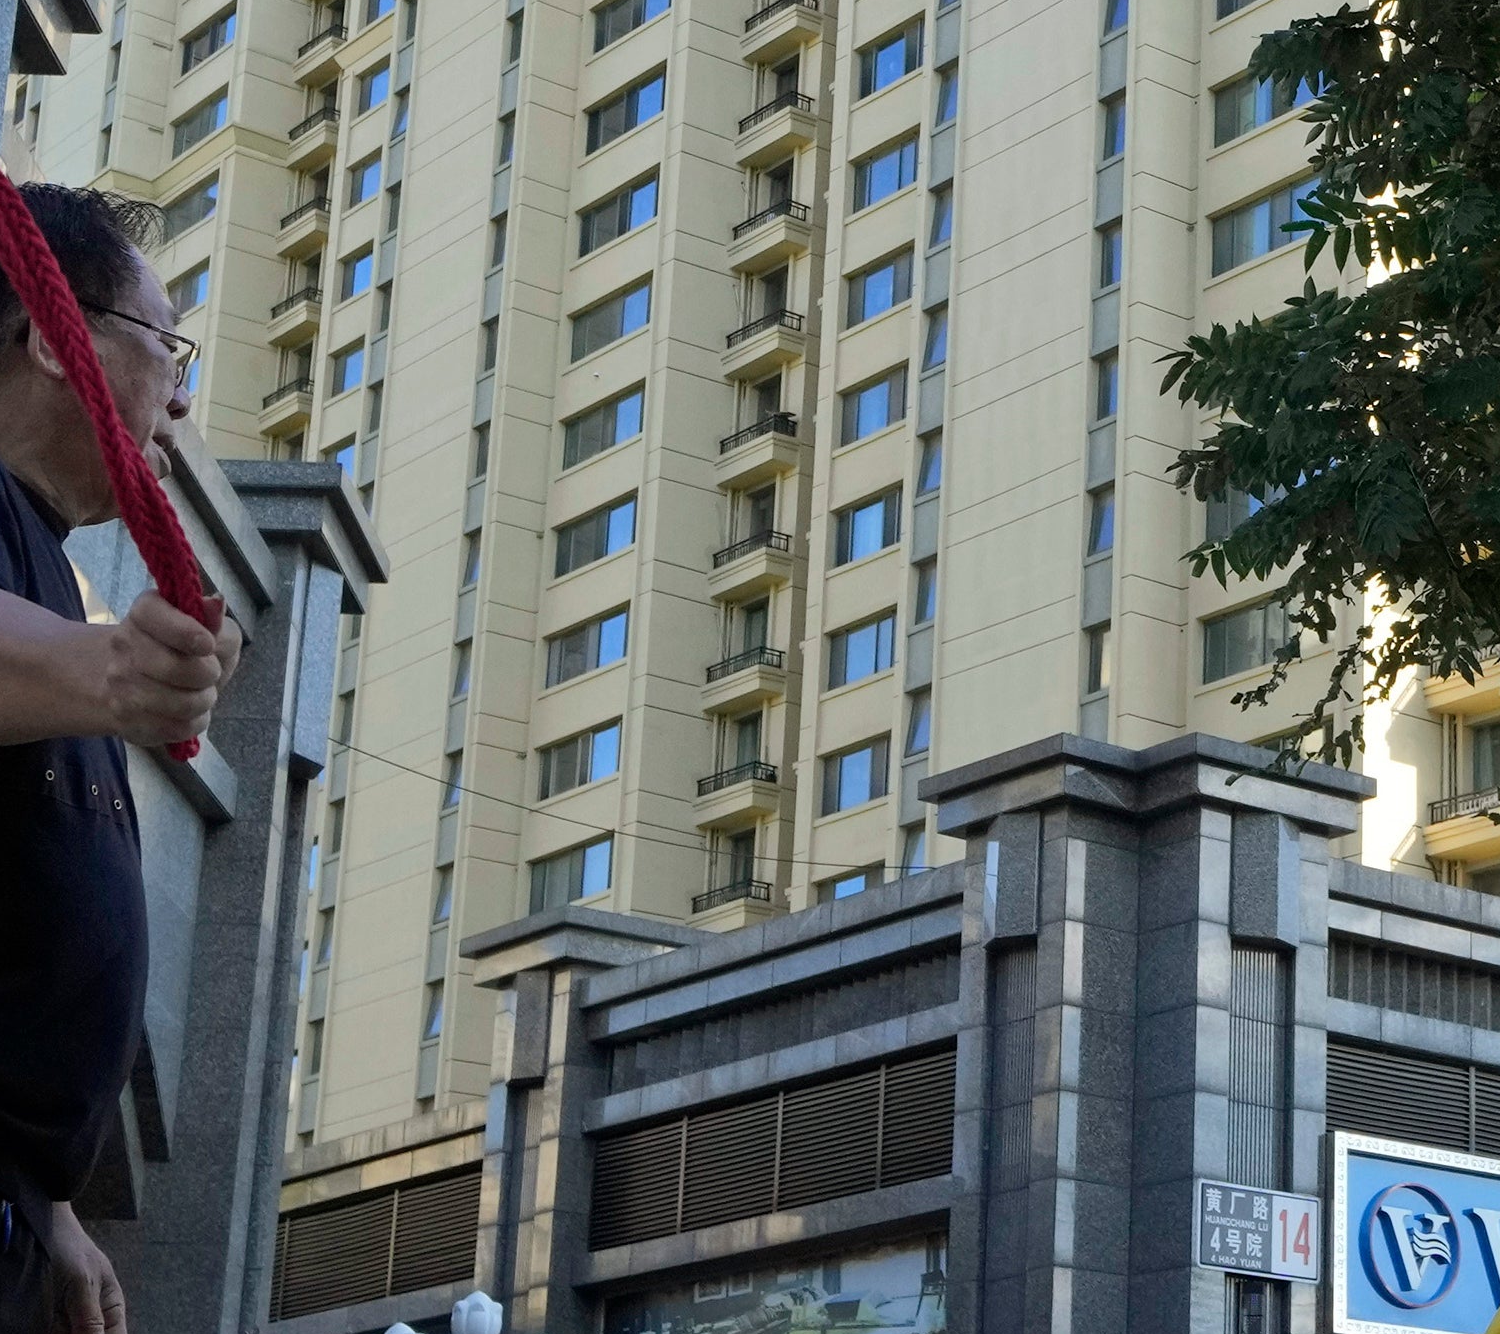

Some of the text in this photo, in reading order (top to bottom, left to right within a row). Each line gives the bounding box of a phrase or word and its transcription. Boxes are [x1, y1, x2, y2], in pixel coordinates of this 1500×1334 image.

[1205, 1187, 1269, 1221] 黄厂路
[1210, 1226, 1263, 1258] 4号院
[1257, 1222, 1269, 1232] LU
[1279, 1208, 1311, 1266] 14
[1218, 1255, 1237, 1266] HAO
[1239, 1258, 1263, 1269] YUAN
